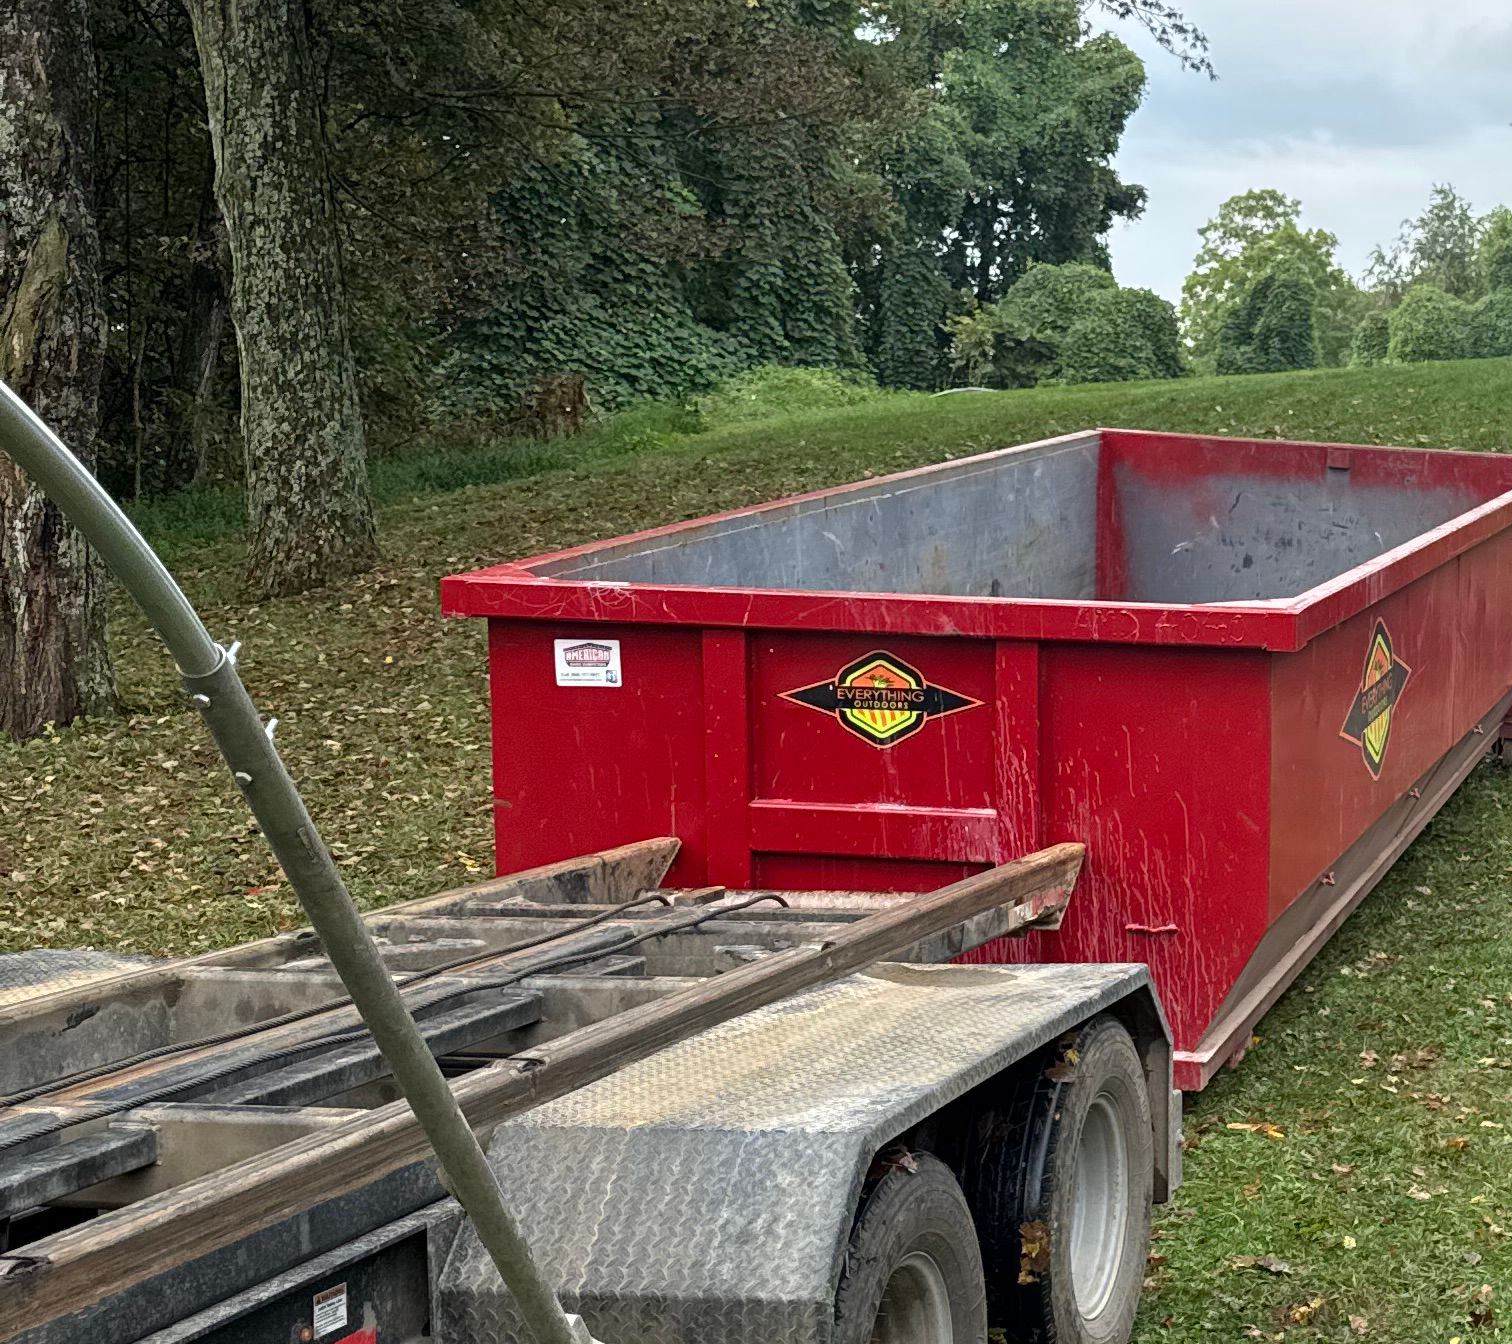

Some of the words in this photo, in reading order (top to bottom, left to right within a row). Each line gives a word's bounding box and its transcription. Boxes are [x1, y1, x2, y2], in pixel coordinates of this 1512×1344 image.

[565, 648, 610, 661] AMERICAN
[837, 688, 925, 702] EVERYTHING
[853, 700, 909, 709] OUTDOORS
